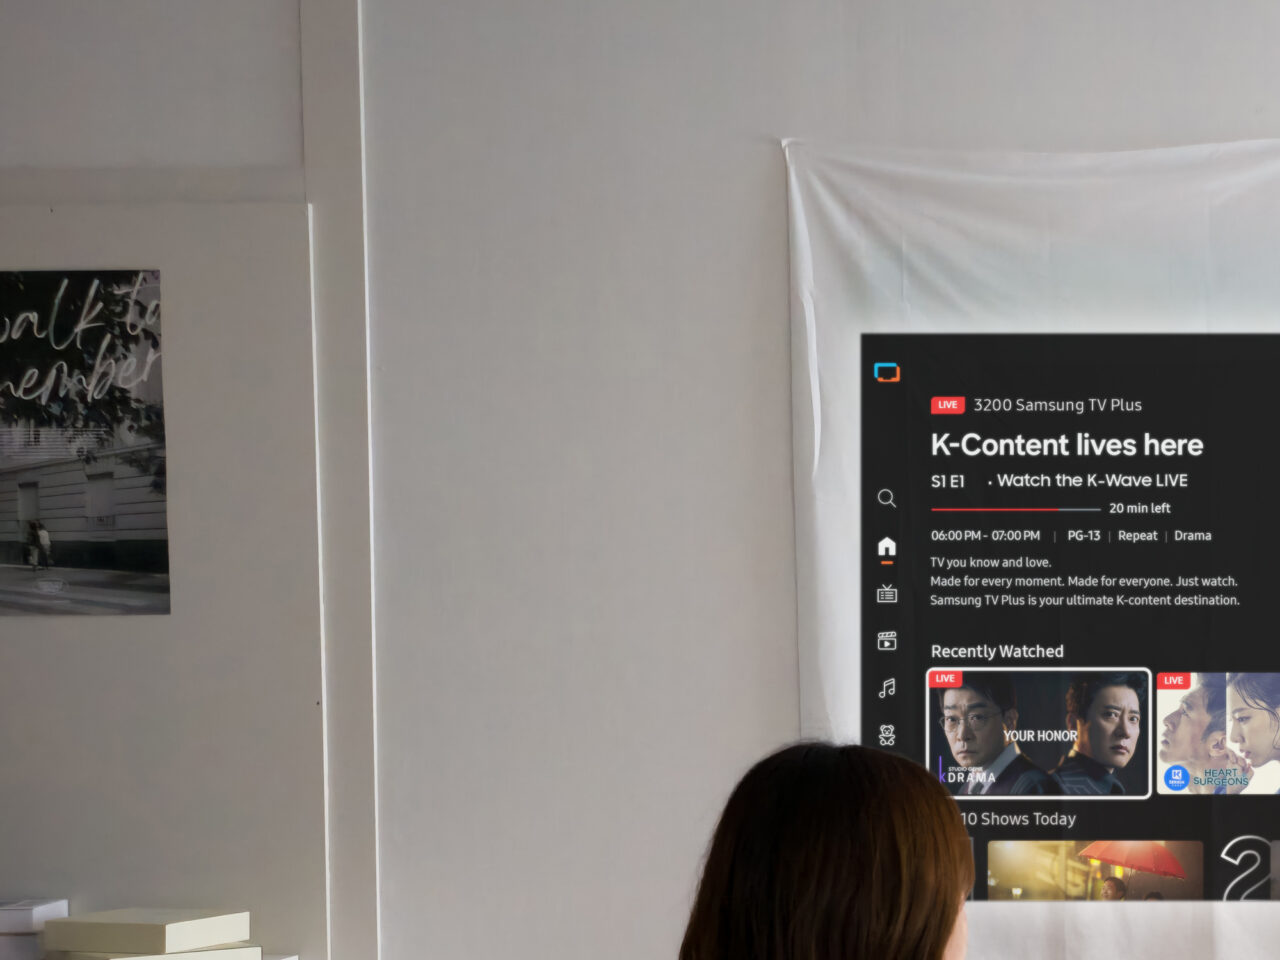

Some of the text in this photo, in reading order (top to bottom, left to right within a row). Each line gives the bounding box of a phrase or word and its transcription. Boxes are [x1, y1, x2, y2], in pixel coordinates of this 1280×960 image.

[938, 400, 958, 409] LIVE
[973, 398, 1143, 415] 3200 Samsung TV Plus
[931, 432, 1204, 457] K-Content lives here
[931, 473, 1188, 489] S1 E1 Watch the K-Wave LIVE
[1109, 501, 1172, 514] 20 min left
[930, 529, 963, 541] 06:00
[991, 529, 1022, 541] 07:00
[1023, 529, 1041, 541] PM
[1067, 529, 1101, 542] PG-13
[1118, 529, 1159, 544] Repeat
[1174, 529, 1212, 541] Drama
[930, 556, 1052, 570] TV you know and love.
[930, 574, 1238, 589] Made for every moment. Made for everyone. Just watch.
[930, 594, 1240, 609] Samsung TV Plus is your ultimate K-content destination.
[931, 643, 1065, 662] Recently Watched
[935, 673, 955, 683] LIVE
[1164, 675, 1184, 685] LIVE
[1003, 729, 1078, 742] YOUR HONOR
[1204, 768, 1238, 778] HEART
[1193, 776, 1249, 786] SURGEONS
[980, 811, 1030, 826] Shows
[1032, 811, 1077, 829] Today
